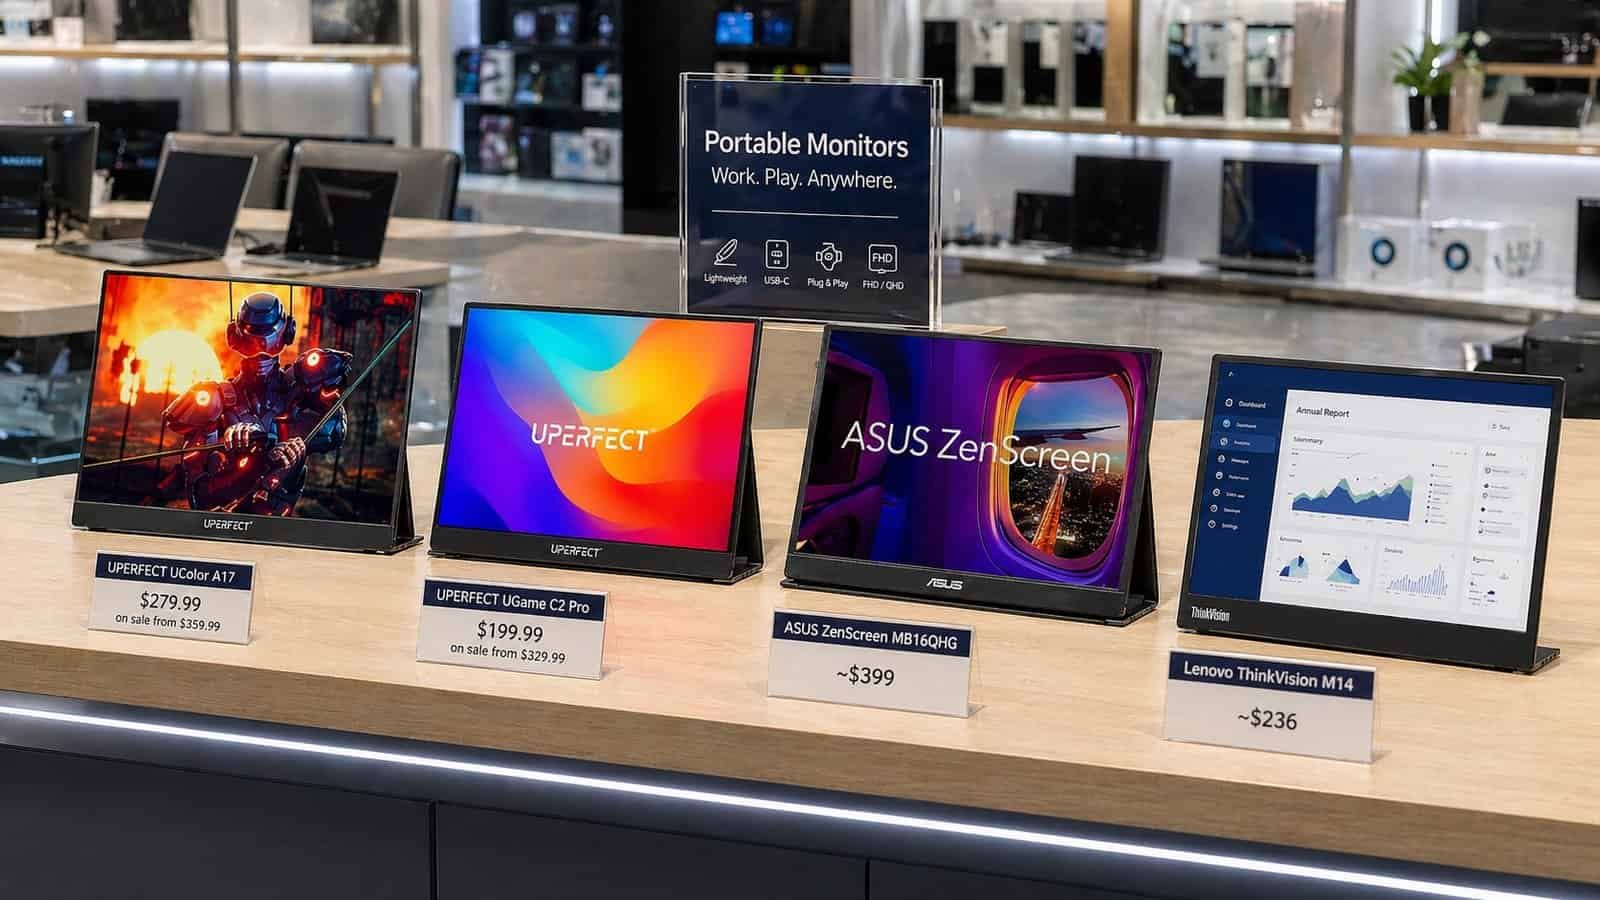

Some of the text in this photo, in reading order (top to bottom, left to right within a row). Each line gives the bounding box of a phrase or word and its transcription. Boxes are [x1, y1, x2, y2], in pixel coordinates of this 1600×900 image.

[705, 130, 909, 158] Portable Monitors
[711, 166, 897, 191] Work. Play. Anywhere.
[872, 252, 893, 263] FHD
[704, 273, 747, 285] Lightweight
[764, 276, 790, 286] USB-C
[807, 278, 849, 289] Plug & Play
[862, 280, 879, 289] FHD
[885, 281, 904, 290] QHD
[1296, 407, 1350, 419] Annual Report
[531, 422, 649, 451] UPERFECT
[841, 420, 1111, 474] ASUS ZenScreen
[203, 519, 250, 531] UPERFECT
[550, 543, 601, 558] UPERFECT
[107, 561, 236, 583] UPERFECT UColor A17
[926, 577, 964, 590] ASUS
[140, 590, 202, 611] $279.99
[436, 588, 590, 614] UPERFECT UGame C2 Pro
[115, 614, 221, 631] on sale from $359.99
[1191, 606, 1230, 622] ThinkVision
[477, 620, 544, 643] $199.99
[784, 621, 958, 650] ASUS ZenScreen MB16QHG
[450, 645, 566, 664] on sale from $329.99
[836, 664, 895, 686] ~$399
[1183, 660, 1354, 691] Lenovo ThinkVision M14
[1237, 707, 1298, 730] ~$236
